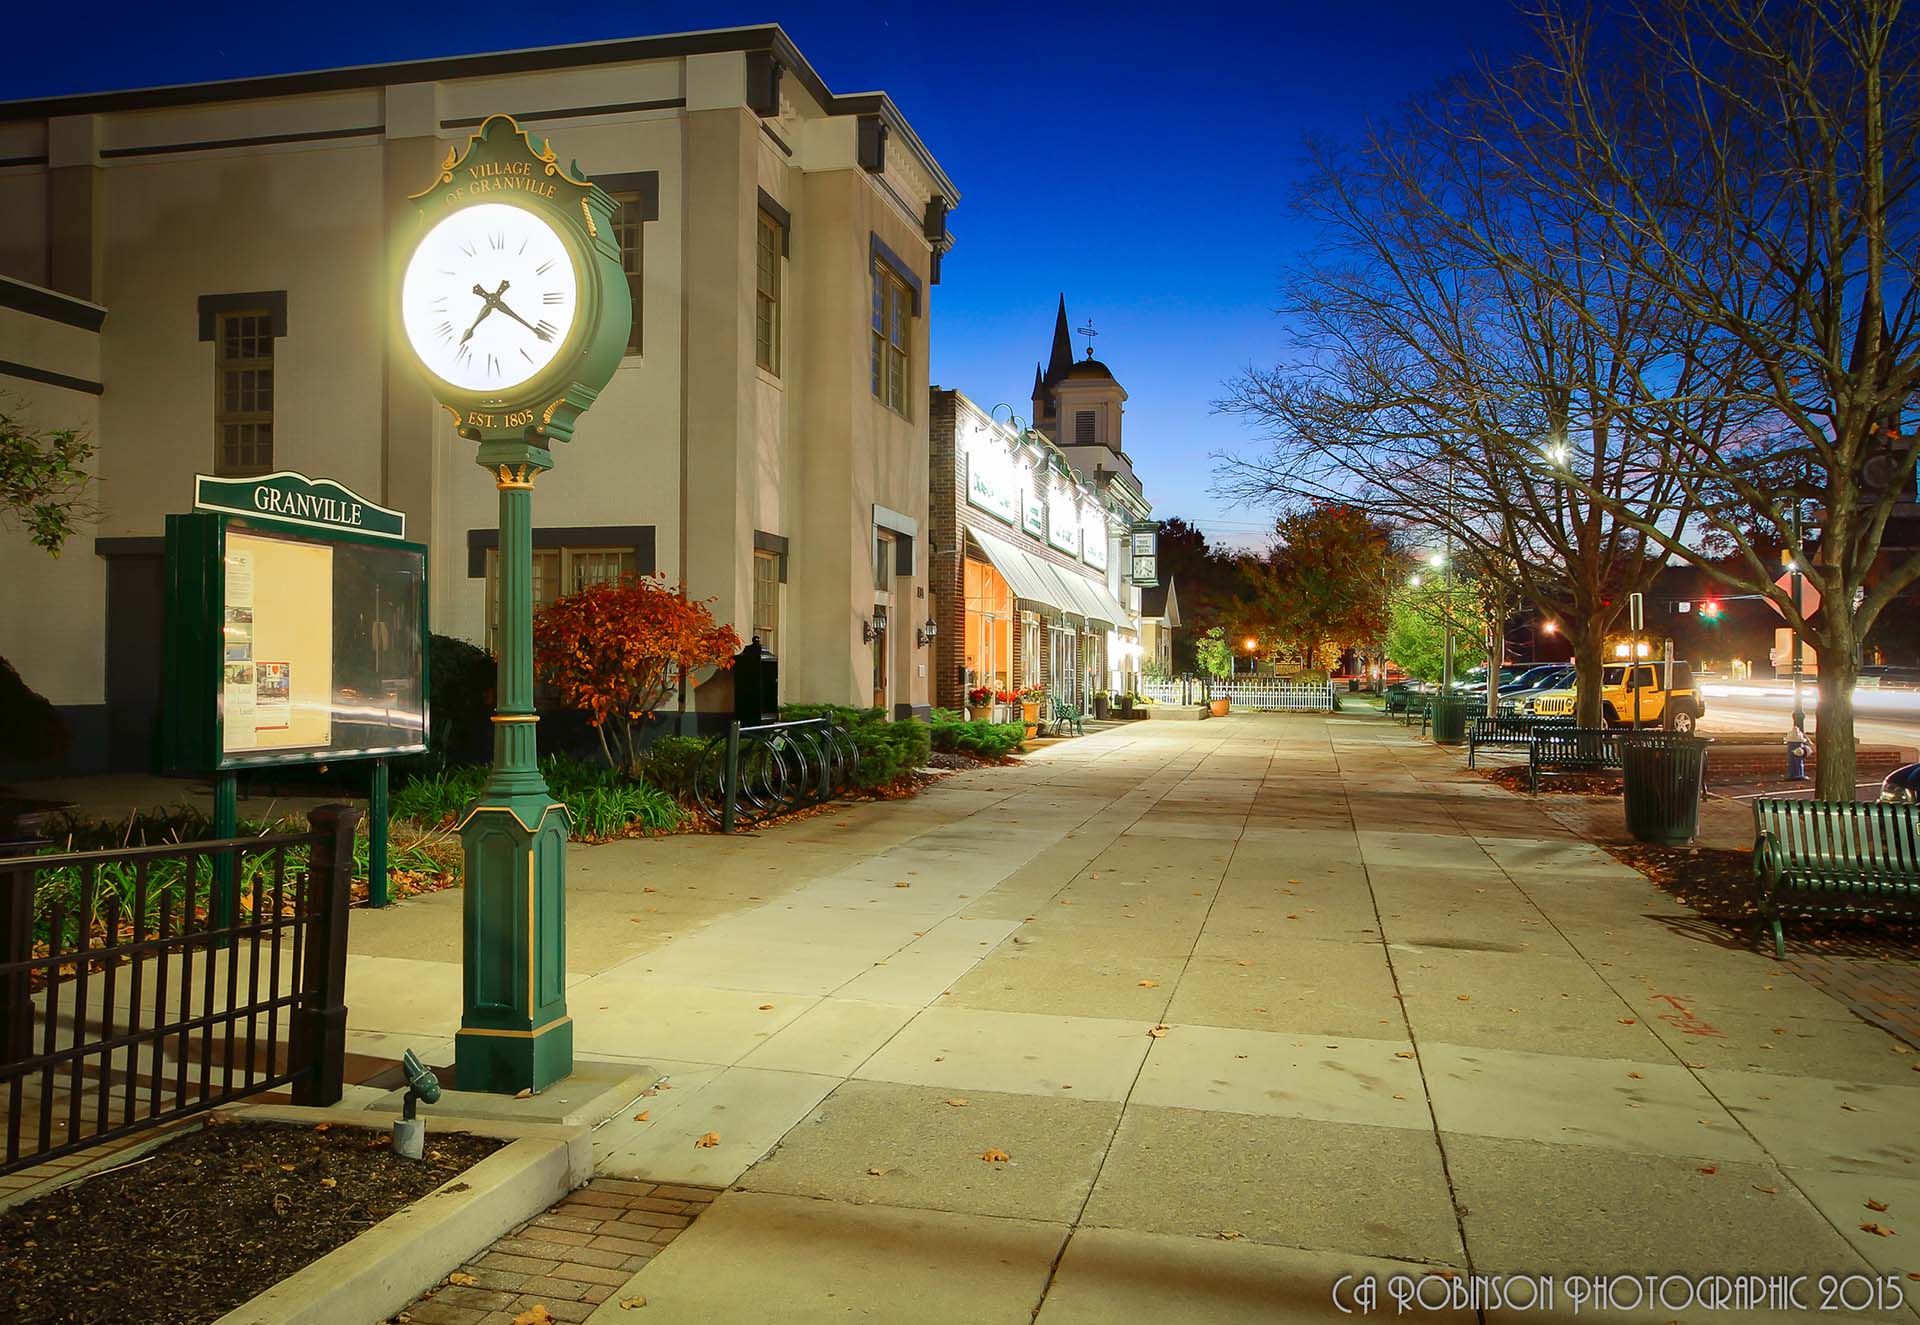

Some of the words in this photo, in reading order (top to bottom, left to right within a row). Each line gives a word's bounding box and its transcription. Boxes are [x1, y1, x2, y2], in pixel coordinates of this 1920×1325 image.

[469, 161, 532, 179] VILLAGE
[446, 187, 465, 203] OF
[469, 176, 556, 199] GRANVILLE
[468, 411, 497, 428] EST.
[504, 410, 534, 427] 1805
[254, 485, 362, 525] GRANVILLE
